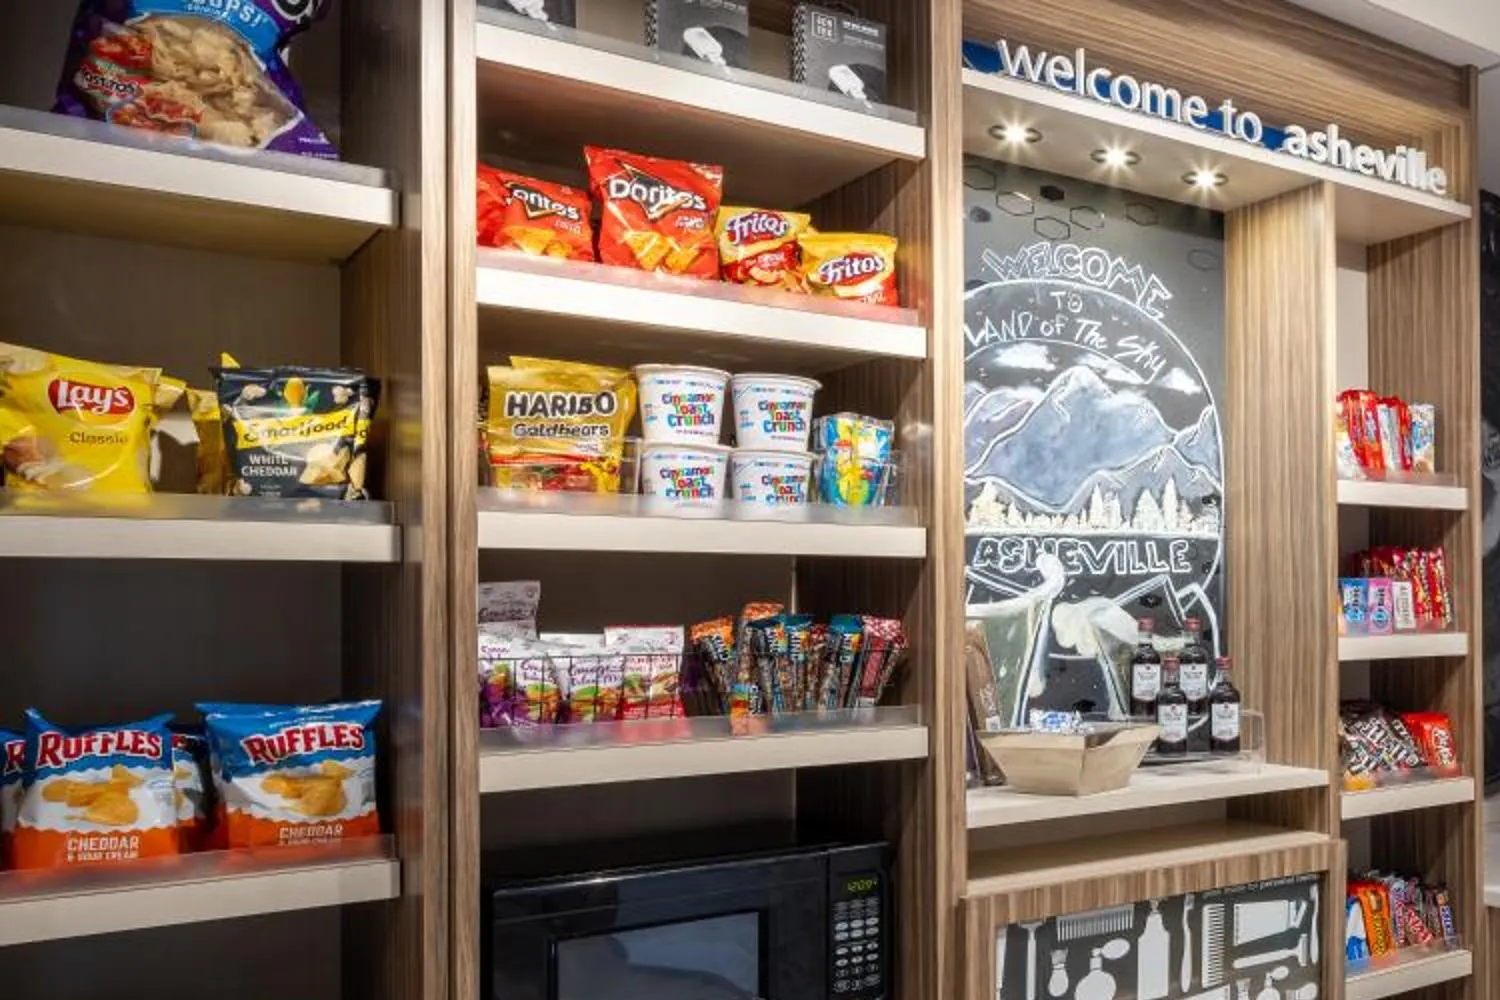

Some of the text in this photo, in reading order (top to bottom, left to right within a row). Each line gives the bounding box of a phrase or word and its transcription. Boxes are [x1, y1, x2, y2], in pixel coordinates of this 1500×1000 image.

[997, 39, 1448, 196] welcome to asheville
[608, 177, 707, 213] Doritos
[727, 212, 790, 245] Fritos
[819, 254, 885, 284] Fritos
[982, 242, 1174, 320] WELCOME
[1050, 290, 1083, 313] TO
[506, 391, 616, 418] HARIBO
[512, 422, 610, 439] Goldbears
[241, 466, 298, 477] CHEDDAR
[36, 730, 163, 768] RUFFLES
[241, 723, 367, 766] RUFFLES
[67, 836, 139, 852] CHEDDAR
